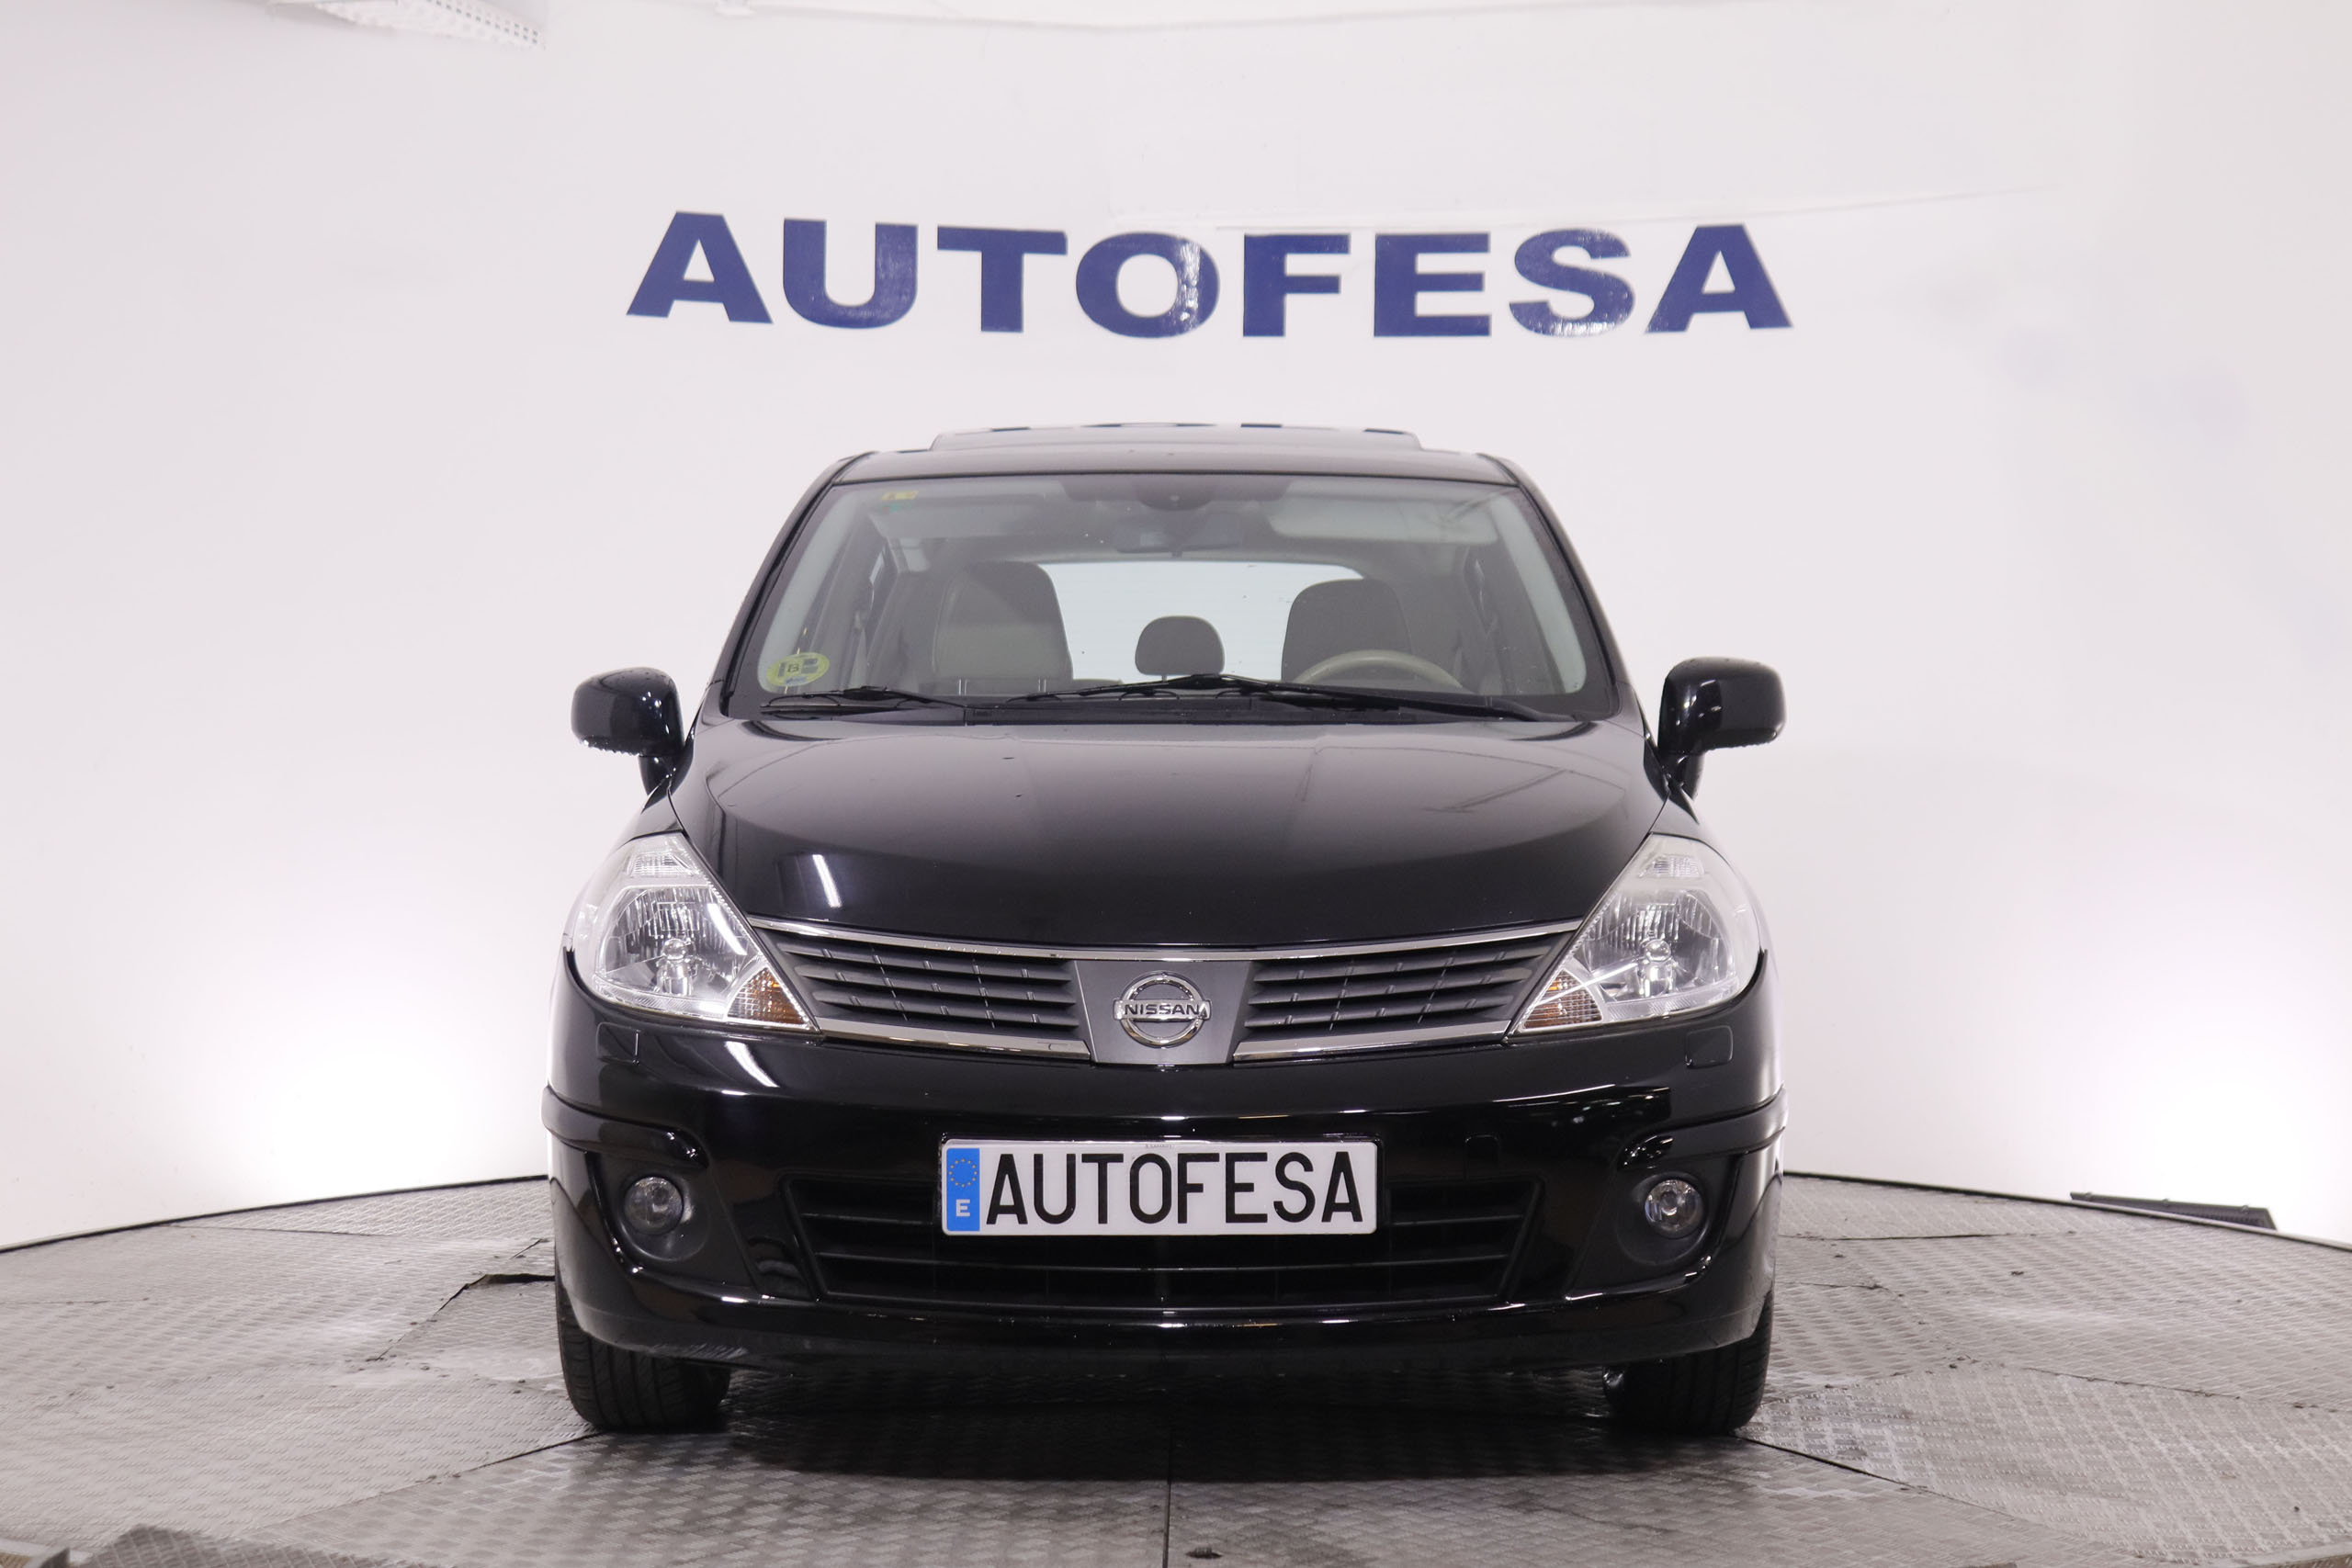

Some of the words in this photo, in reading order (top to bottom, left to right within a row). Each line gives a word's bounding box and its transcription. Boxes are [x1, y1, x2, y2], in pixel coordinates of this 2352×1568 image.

[626, 210, 1792, 338] AUTOFESA
[1125, 1004, 1199, 1015] NISSAN
[956, 1199, 971, 1217] E
[986, 1151, 1363, 1225] AUTOFESA
